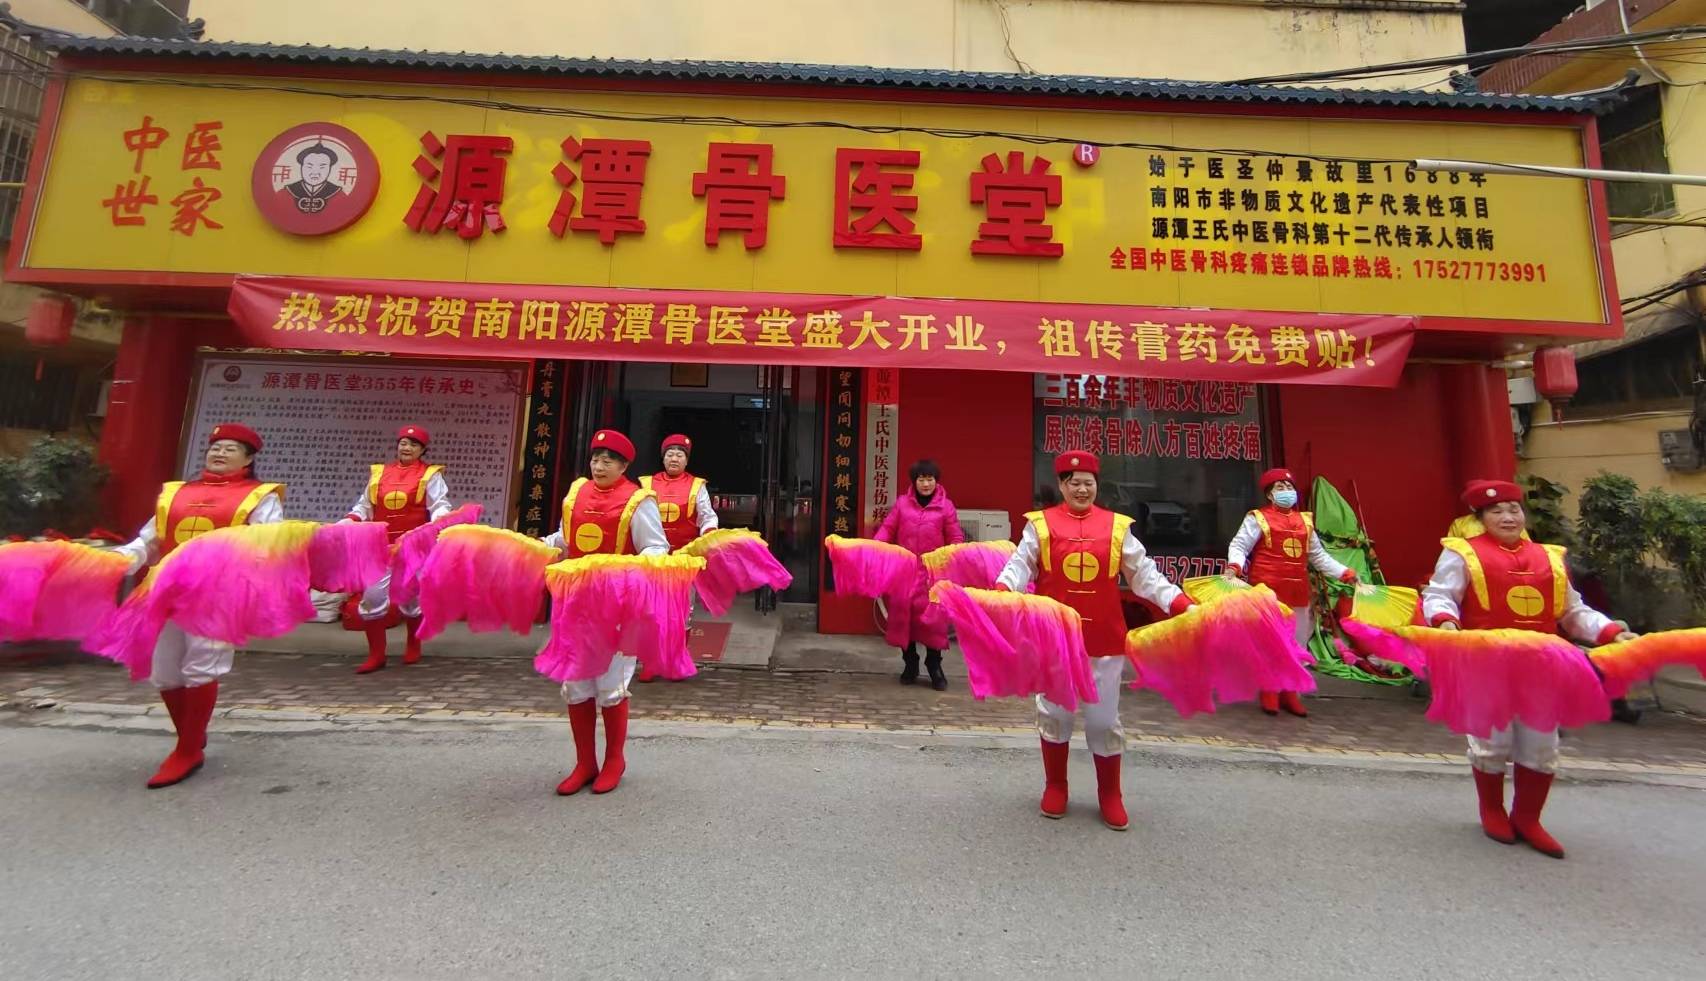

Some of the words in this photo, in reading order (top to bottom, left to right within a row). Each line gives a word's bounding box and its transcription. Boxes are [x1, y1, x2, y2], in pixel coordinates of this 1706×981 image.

[123, 115, 224, 175] 中医
[102, 175, 224, 236] 世家
[402, 131, 1063, 257] 源潭骨医堂
[1150, 185, 1489, 219] 南阳市非物质文化遗产代表性项目
[262, 371, 475, 394] 源潭骨医堂355年传承史
[1044, 414, 1262, 461] 展筋续骨除八方百姓疼痛
